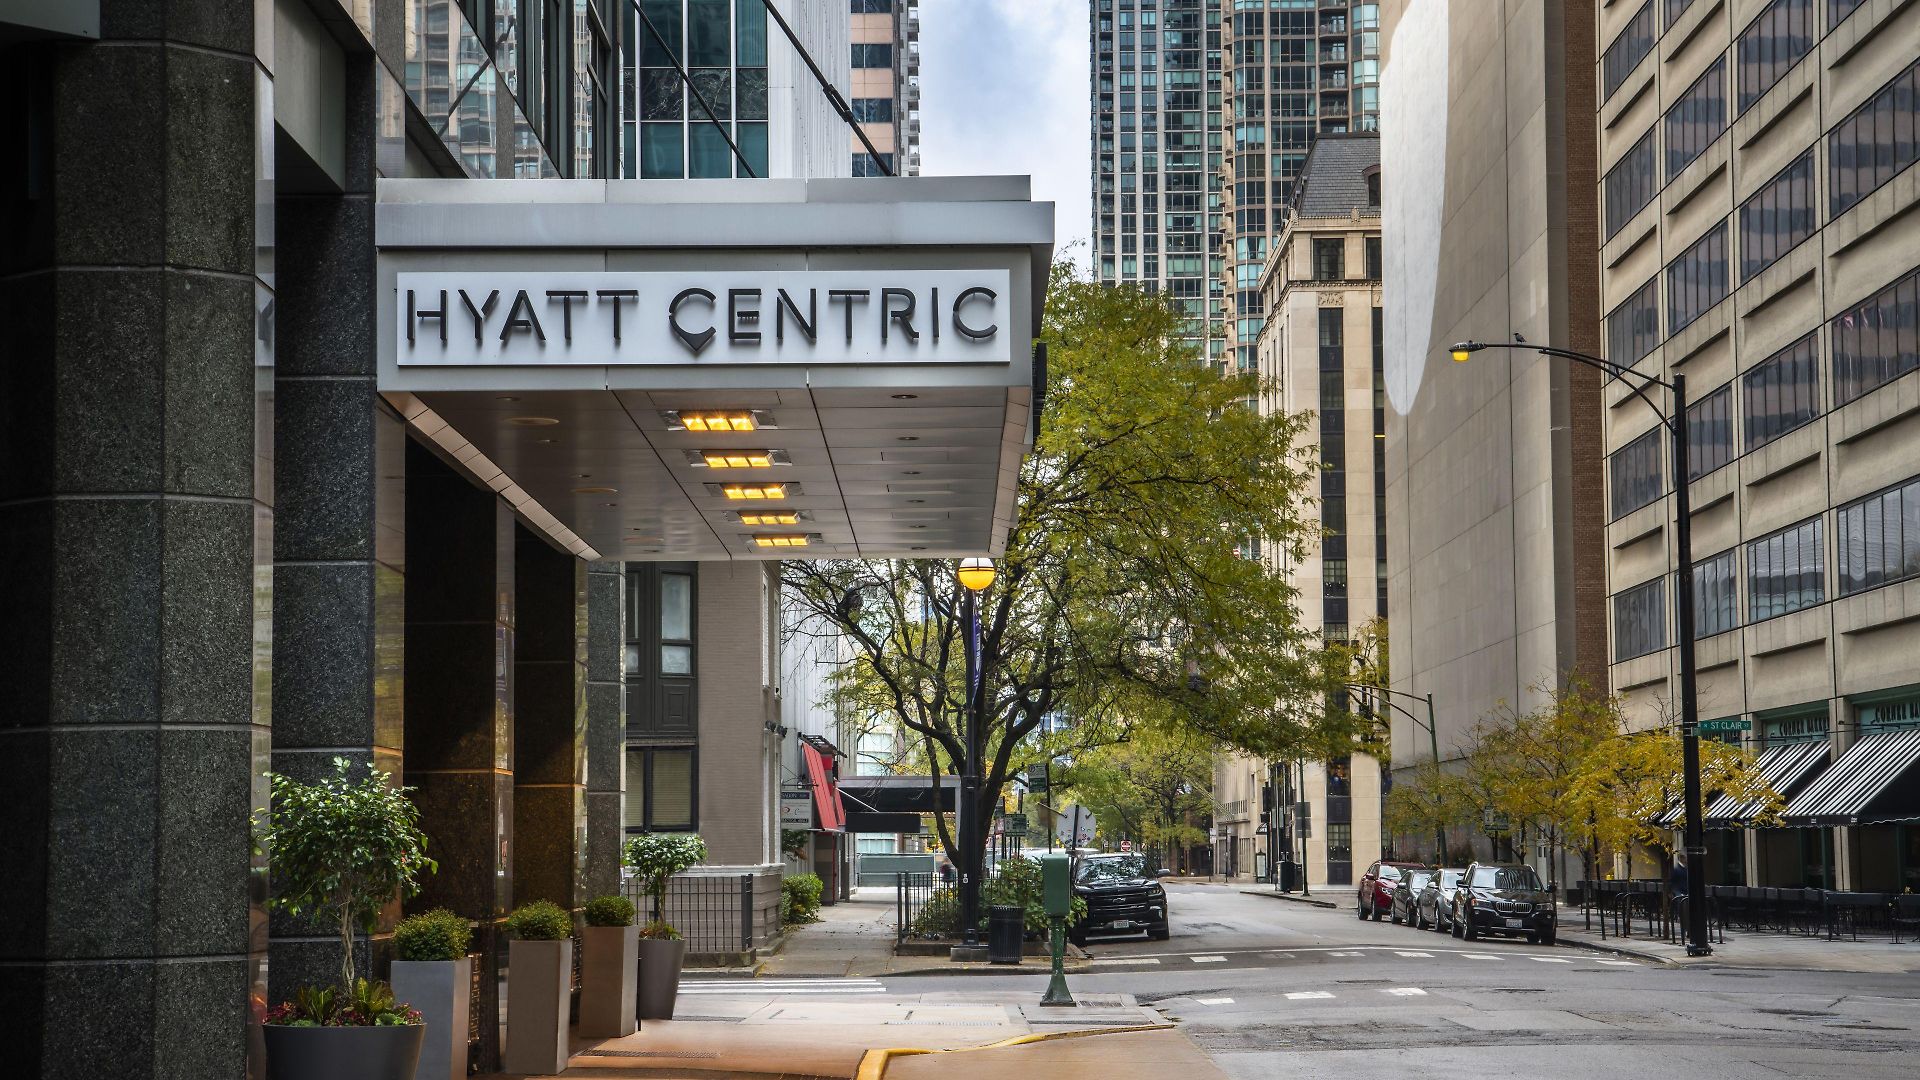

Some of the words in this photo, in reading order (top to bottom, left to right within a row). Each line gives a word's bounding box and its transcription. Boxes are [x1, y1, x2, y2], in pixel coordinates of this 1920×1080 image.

[407, 289, 639, 341] HYATT
[668, 287, 998, 352] CENTRIC
[1710, 721, 1719, 730] ST
[1721, 721, 1742, 730] CLAIR
